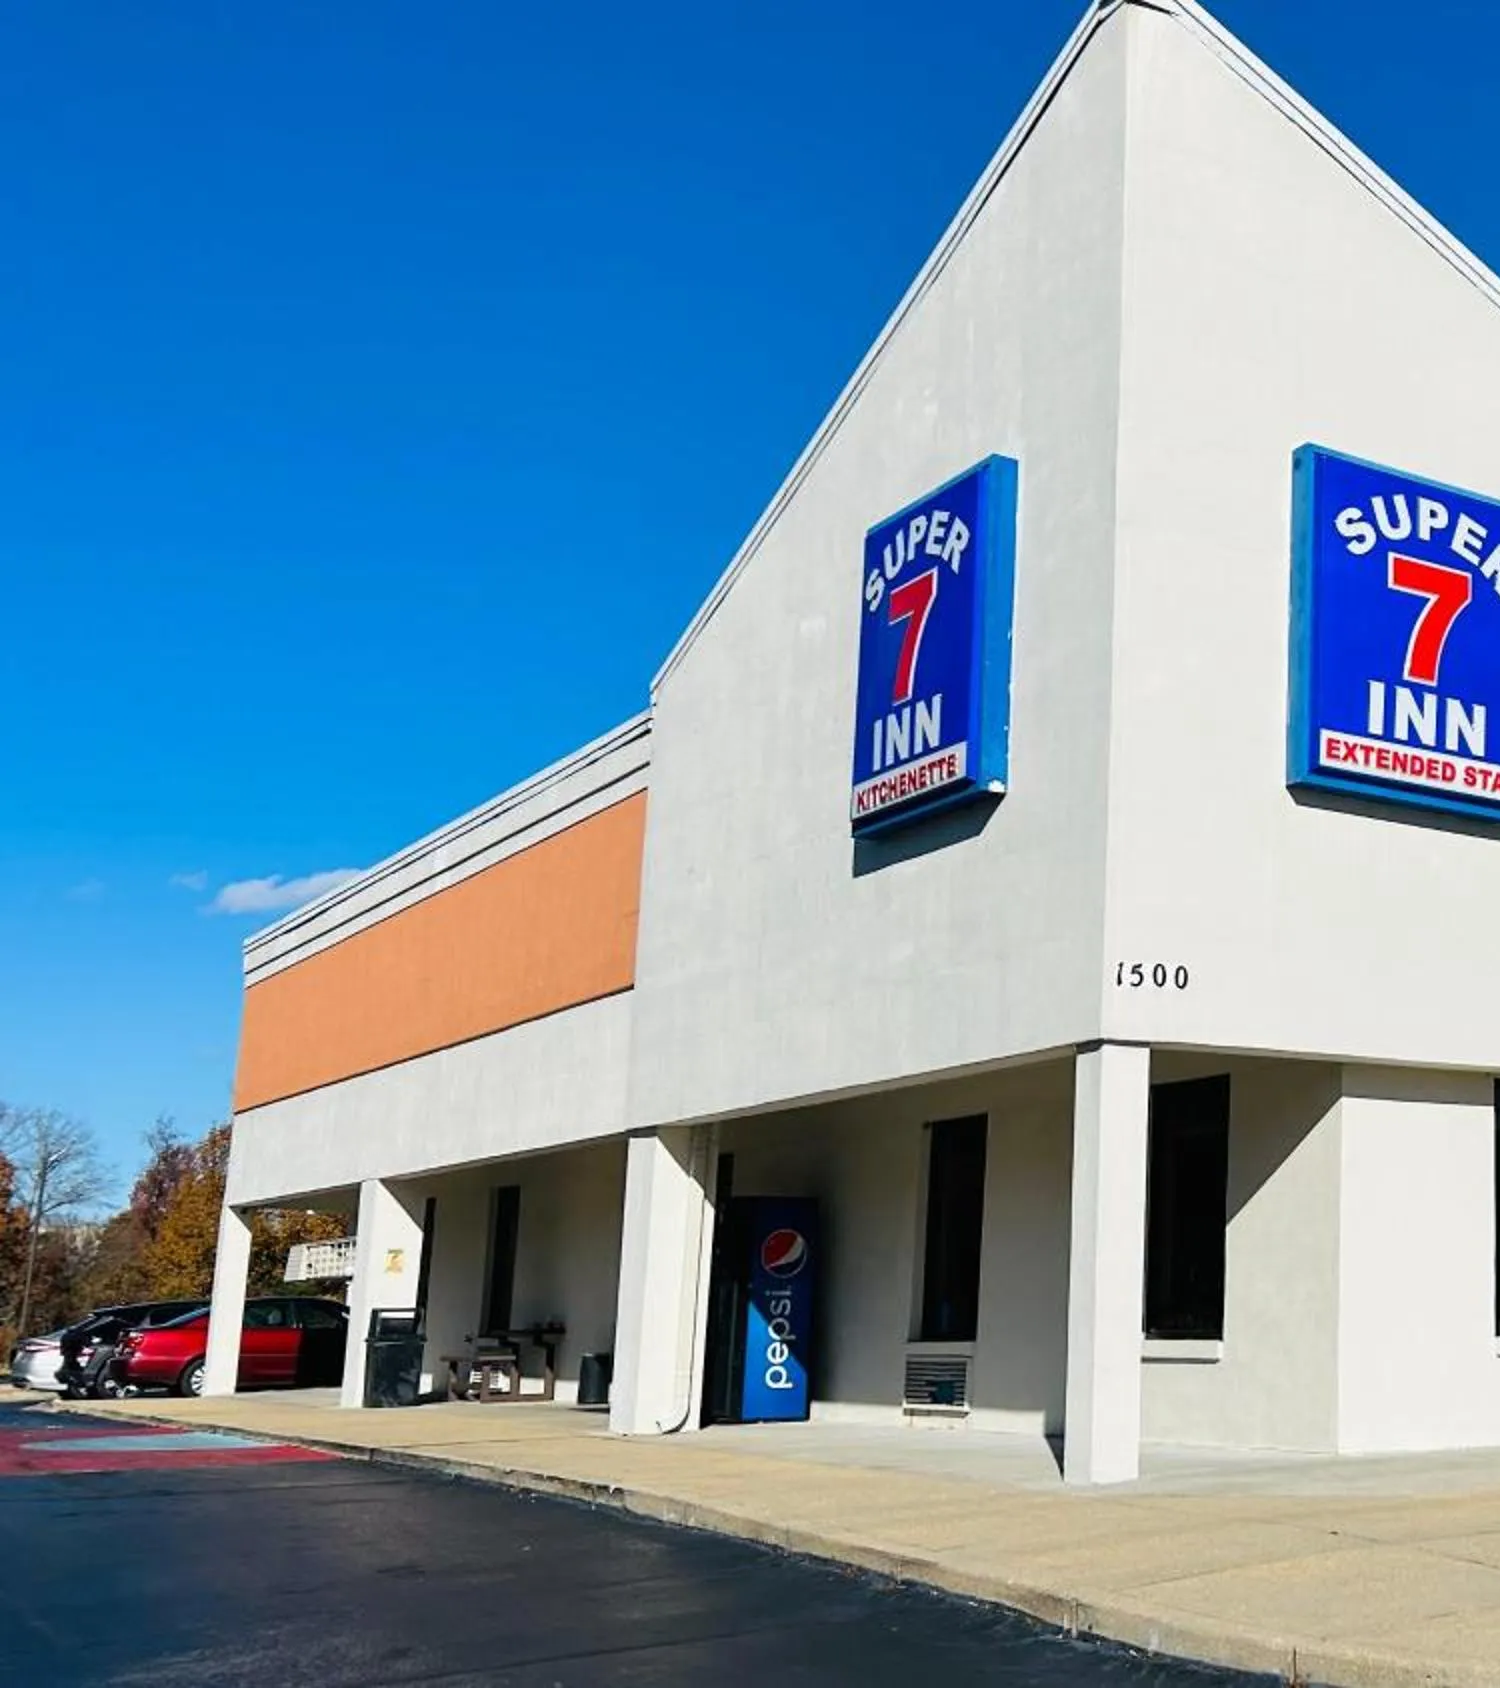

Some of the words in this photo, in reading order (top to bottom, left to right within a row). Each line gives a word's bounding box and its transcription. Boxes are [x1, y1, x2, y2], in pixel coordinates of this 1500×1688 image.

[865, 509, 970, 613] SUPER
[888, 566, 938, 706] 7
[1388, 551, 1472, 687] 7
[872, 693, 943, 772] INN
[1367, 679, 1486, 757] INN
[856, 753, 958, 813] KITCHENETTE
[1325, 737, 1456, 783] EXTENDED
[1117, 962, 1189, 990] 1500
[765, 1289, 796, 1389] pepsi
